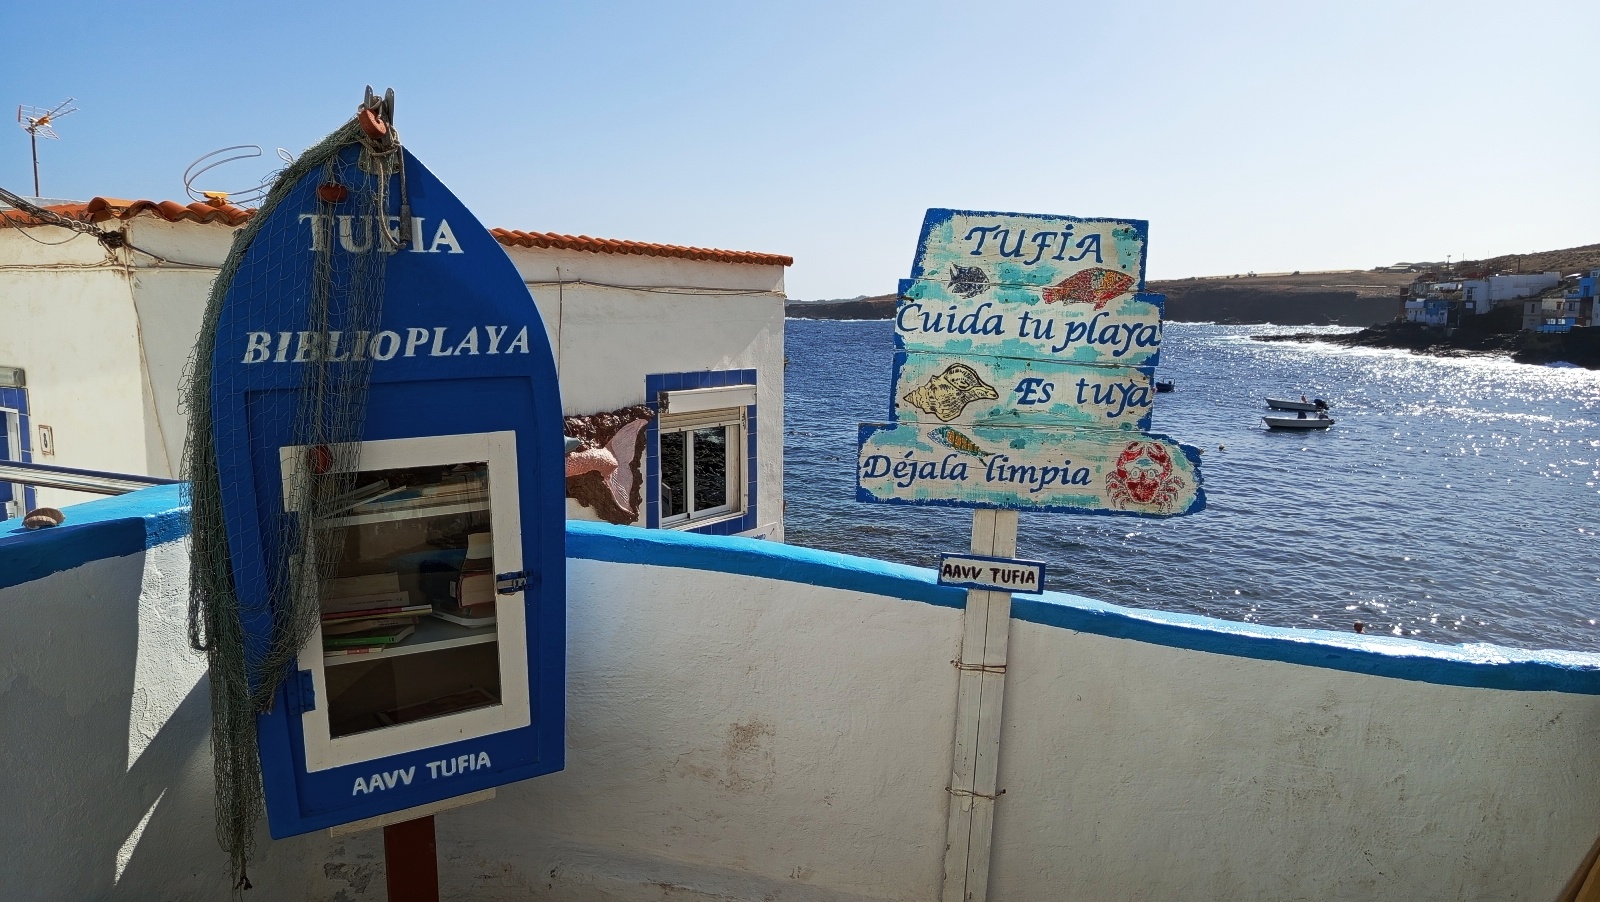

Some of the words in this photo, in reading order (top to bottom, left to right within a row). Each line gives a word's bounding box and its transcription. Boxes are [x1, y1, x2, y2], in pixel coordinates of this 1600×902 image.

[241, 325, 530, 364] BIBLIOPLAYA
[896, 302, 1005, 336] Cuida
[1017, 311, 1055, 338] tu
[1052, 312, 1160, 357] playa
[1014, 377, 1055, 405] Es
[1075, 377, 1152, 418] tuya
[862, 450, 969, 488] Déjala
[985, 454, 1092, 493] limpia
[942, 563, 982, 580] AAVV
[989, 567, 1035, 585] TUFIA
[352, 766, 416, 796] AAVV
[426, 751, 492, 779] TUFIA
